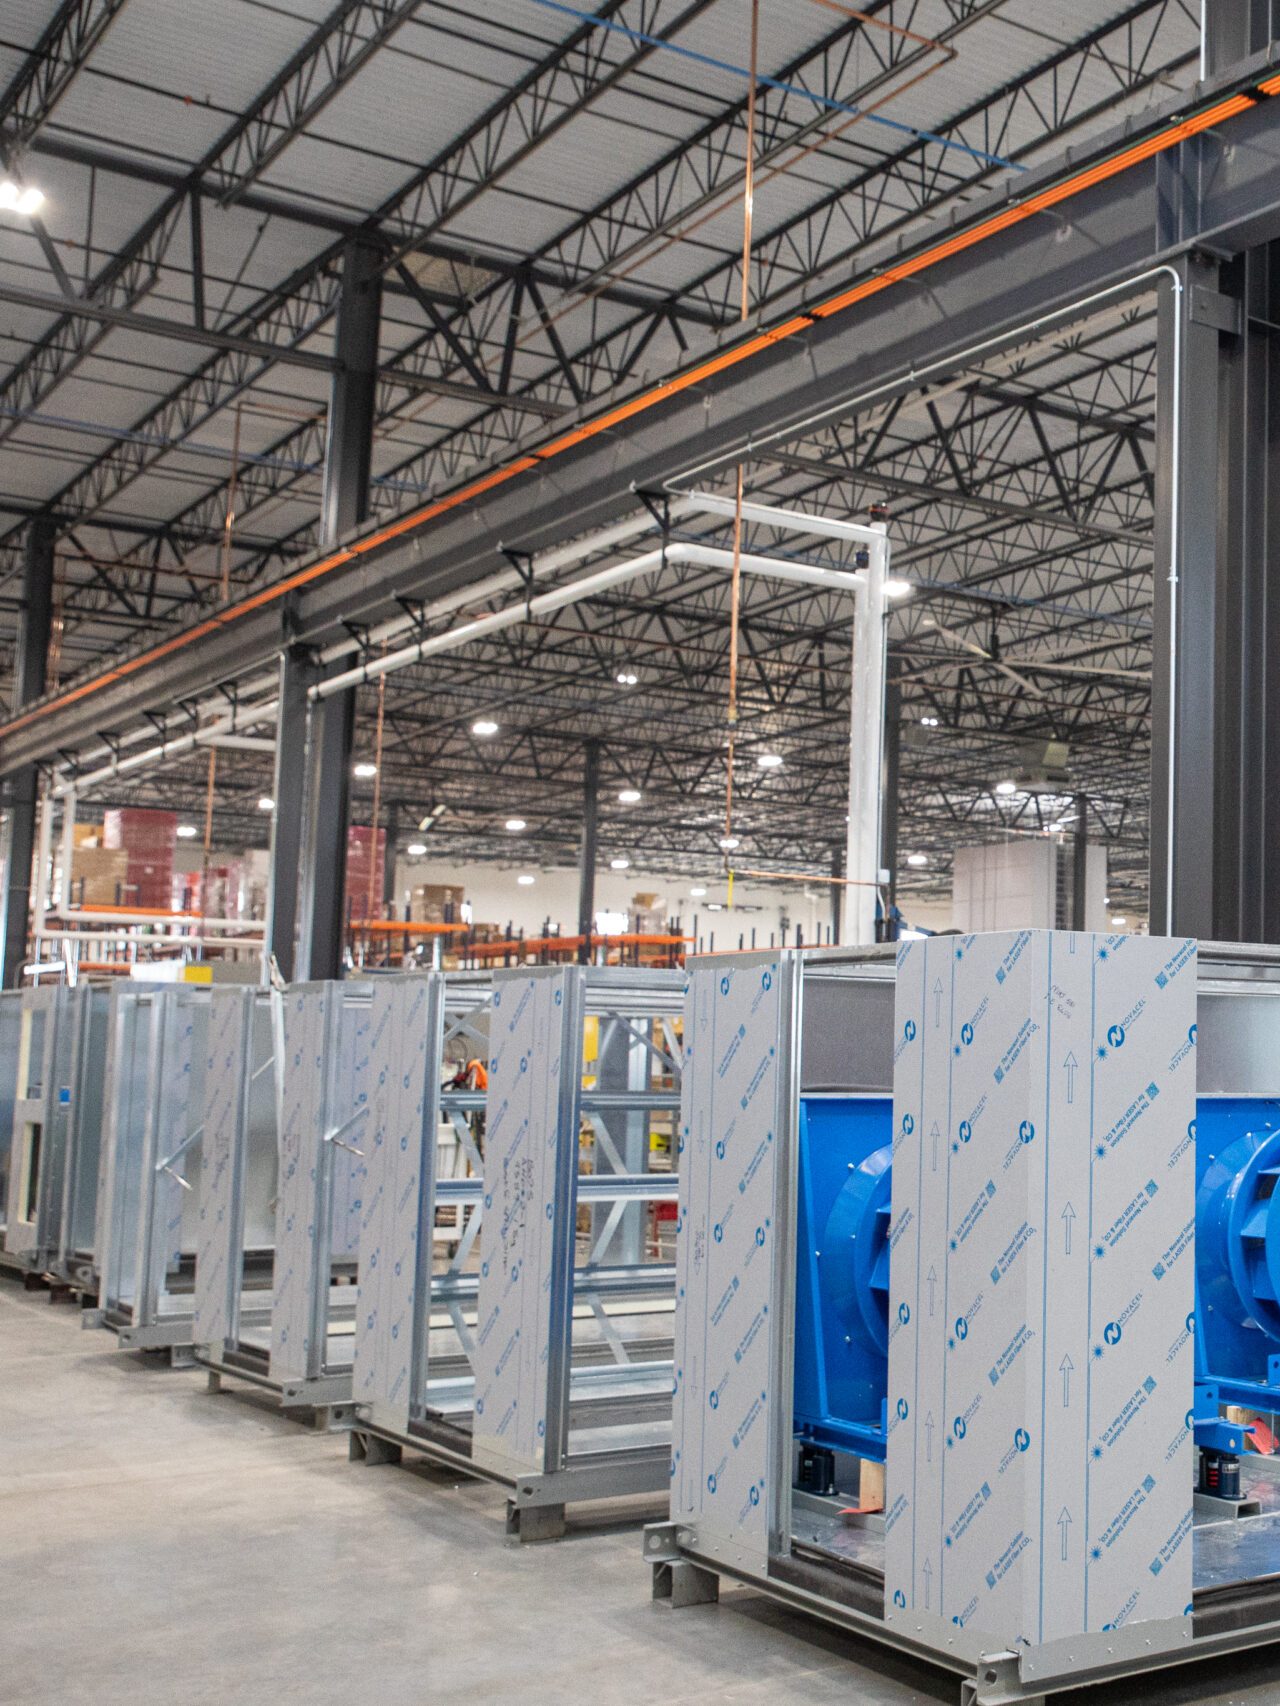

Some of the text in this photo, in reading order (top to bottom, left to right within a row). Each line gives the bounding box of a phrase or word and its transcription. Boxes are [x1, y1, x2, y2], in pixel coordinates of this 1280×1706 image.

[1121, 998, 1146, 1027] NOVACEL
[1169, 1043, 1193, 1071] NOVACEL
[1168, 1139, 1192, 1168] NOVACEL
[1118, 1293, 1143, 1324] NOVACEL
[1167, 1330, 1191, 1362] NOVACEL
[1165, 1428, 1190, 1463] NOVACEL
[1114, 1590, 1140, 1626] NOVACEL
